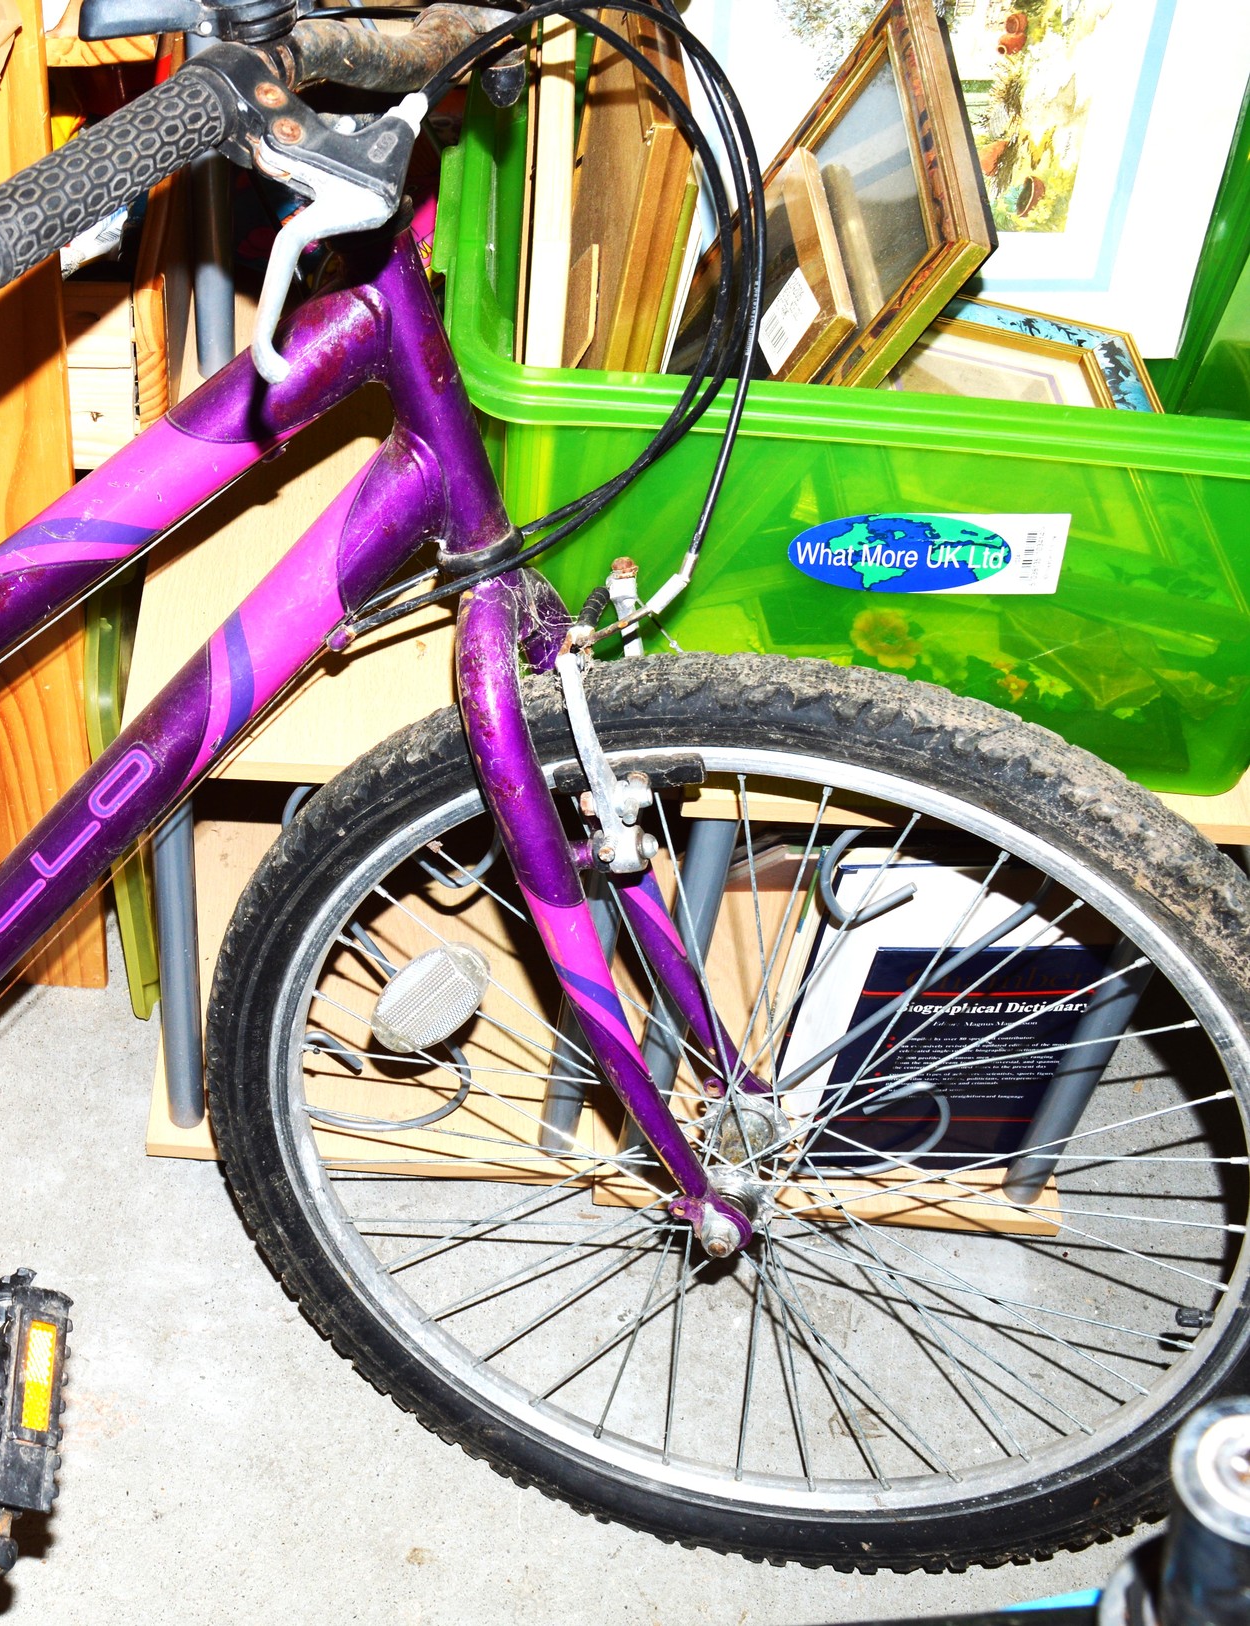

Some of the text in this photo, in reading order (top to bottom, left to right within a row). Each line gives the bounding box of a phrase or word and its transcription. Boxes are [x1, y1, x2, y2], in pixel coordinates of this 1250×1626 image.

[795, 541, 1005, 569] What More UK Ltd
[906, 967, 1097, 990] Chmber
[1004, 1001, 1088, 1013] Dictinary
